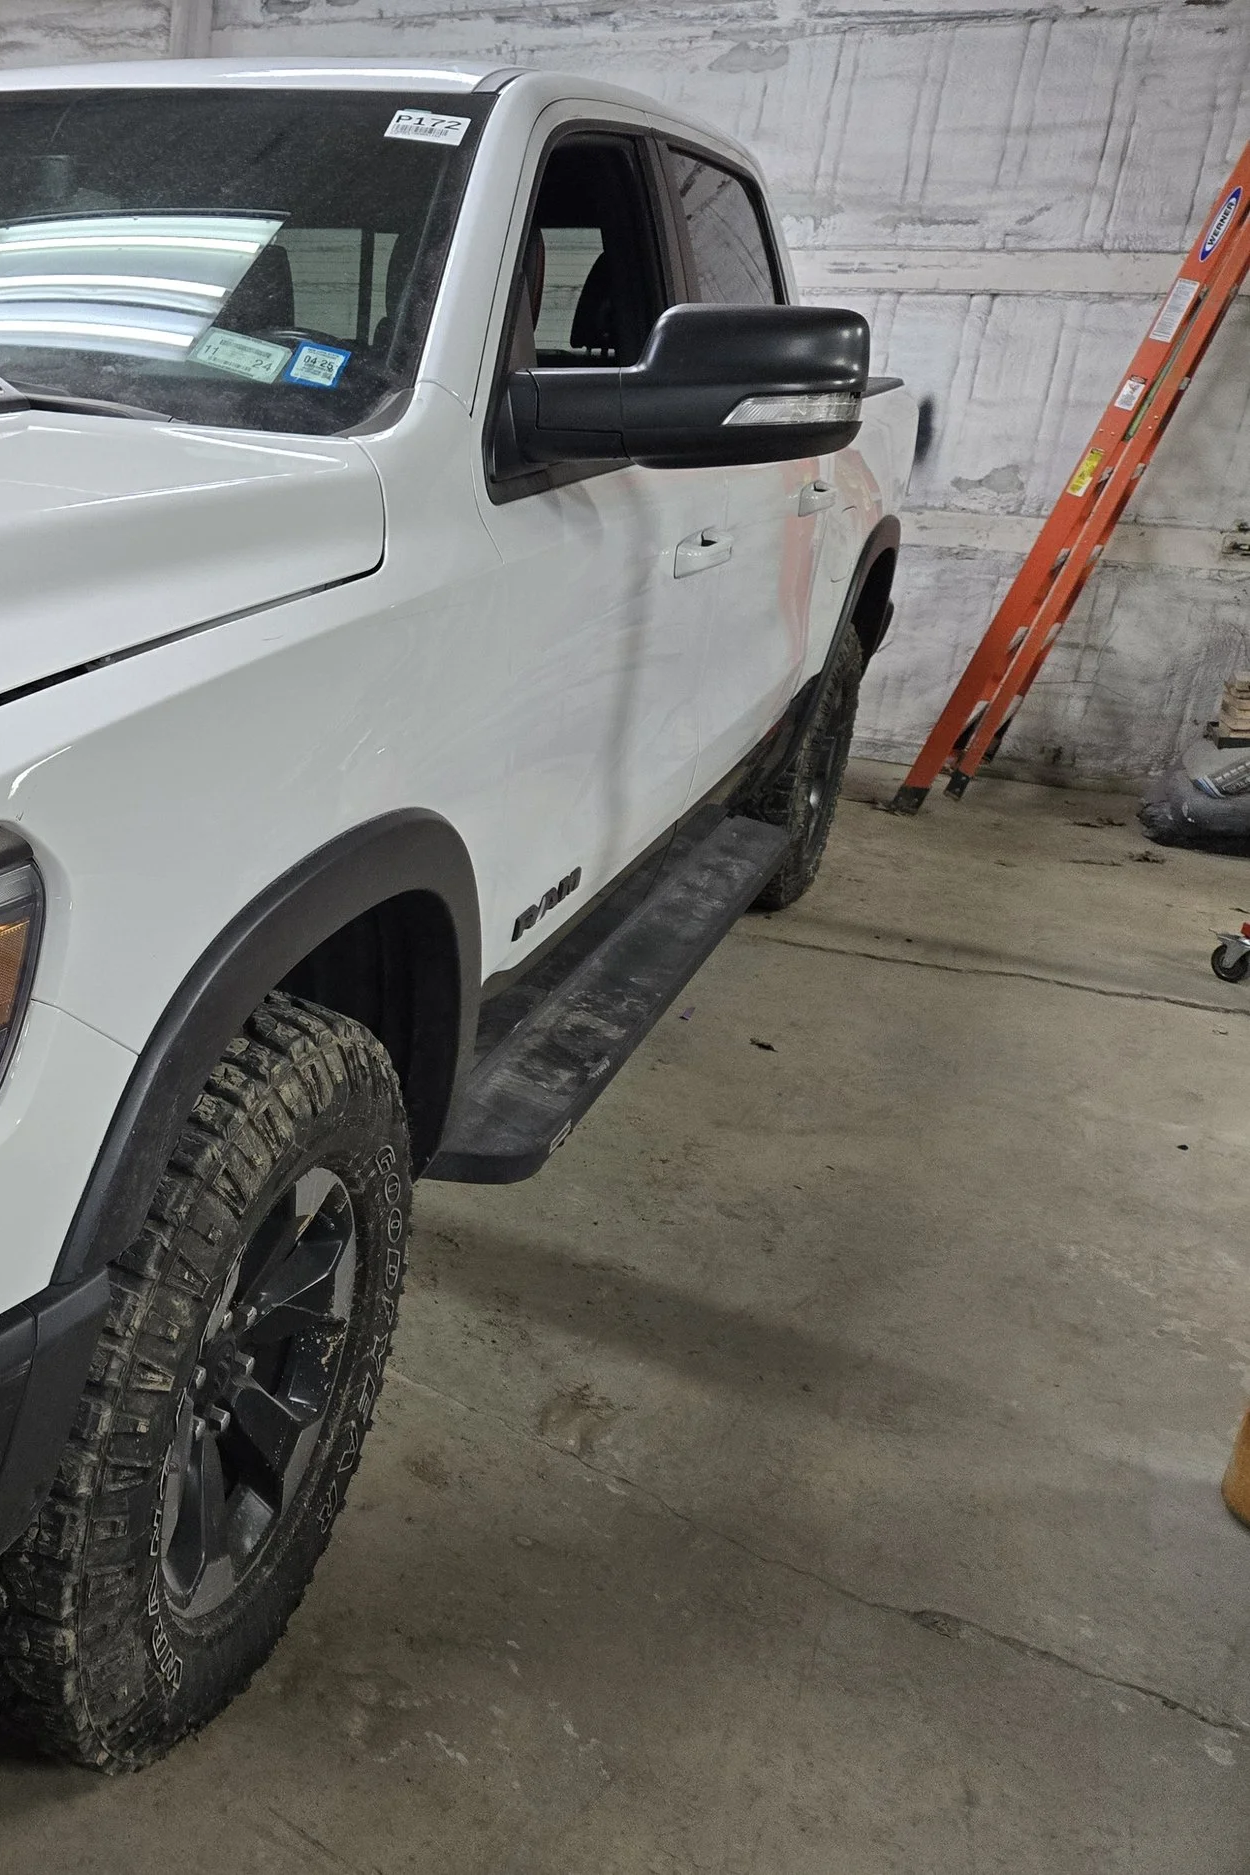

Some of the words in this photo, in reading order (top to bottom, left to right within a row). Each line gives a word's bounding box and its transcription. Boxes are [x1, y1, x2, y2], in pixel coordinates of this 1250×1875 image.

[395, 115, 462, 131] P172
[1207, 202, 1236, 246] WERNER
[252, 359, 273, 372] 24
[303, 355, 318, 364] 04
[511, 866, 582, 942] RAM
[318, 1143, 403, 1534] GOODYEAR
